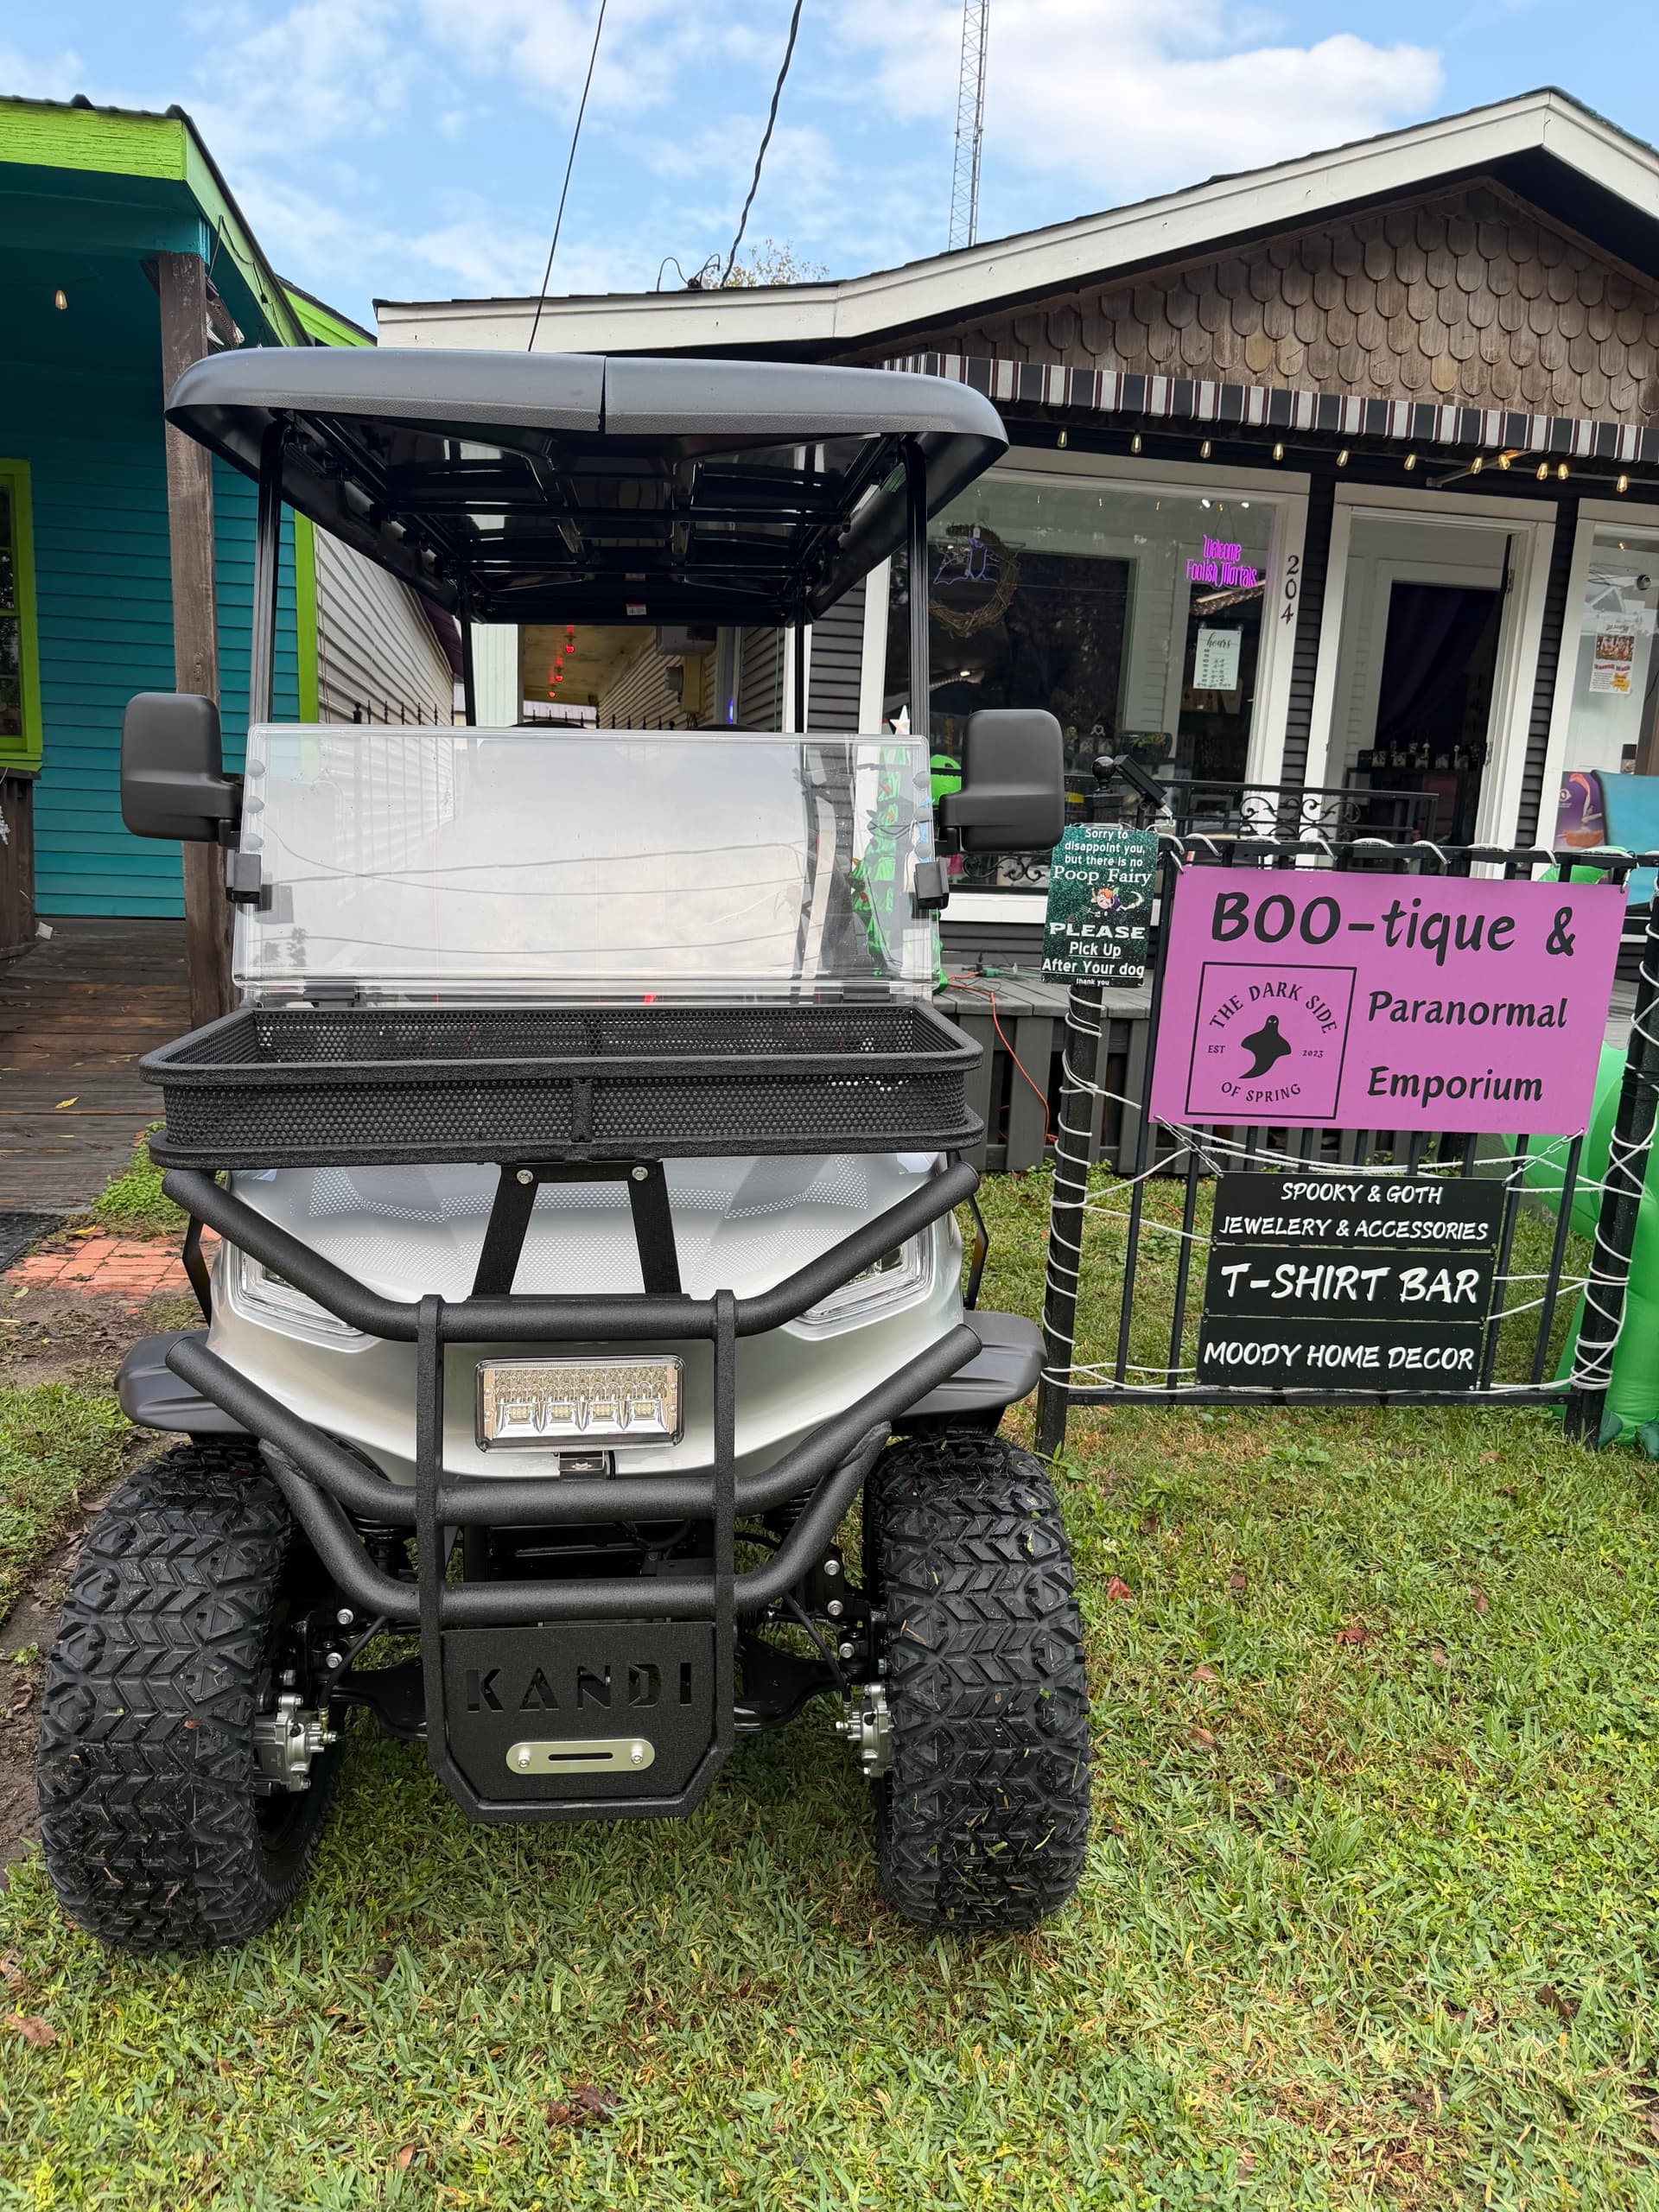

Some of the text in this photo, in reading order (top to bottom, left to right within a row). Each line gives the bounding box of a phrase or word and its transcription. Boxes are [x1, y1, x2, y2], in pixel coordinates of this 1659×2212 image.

[1203, 534, 1242, 563] Welcome
[1185, 558, 1257, 588] Foolish Mortals
[1281, 555, 1300, 625] 204
[1085, 829, 1128, 841] Sorry to
[1065, 841, 1146, 855] disappoint you,
[1065, 855, 1143, 868] but there is no
[1052, 865, 1152, 887] Poop Fairy
[1049, 921, 1146, 940] PLEASE
[1211, 892, 1575, 966] BOO-tique &
[1070, 941, 1122, 958] Pick Up
[1041, 957, 1145, 978] After Your dog
[1076, 977, 1110, 987] thank you
[1210, 982, 1338, 1034] THE DARK SIDE
[1368, 990, 1568, 1028] Paranormal
[1207, 1045, 1324, 1058] EST 2023
[1221, 1082, 1301, 1103] OF SPRING
[1367, 1066, 1543, 1108] Emporium
[1281, 1182, 1444, 1205] SPOOKY & GOTH
[1219, 1216, 1489, 1241] JEWELERY & ACCESSORIES
[1221, 1262, 1479, 1304] T-SHIRT BAR
[1204, 1341, 1474, 1370] MOODY HOME DECOR
[467, 1662, 692, 1713] KANDI
